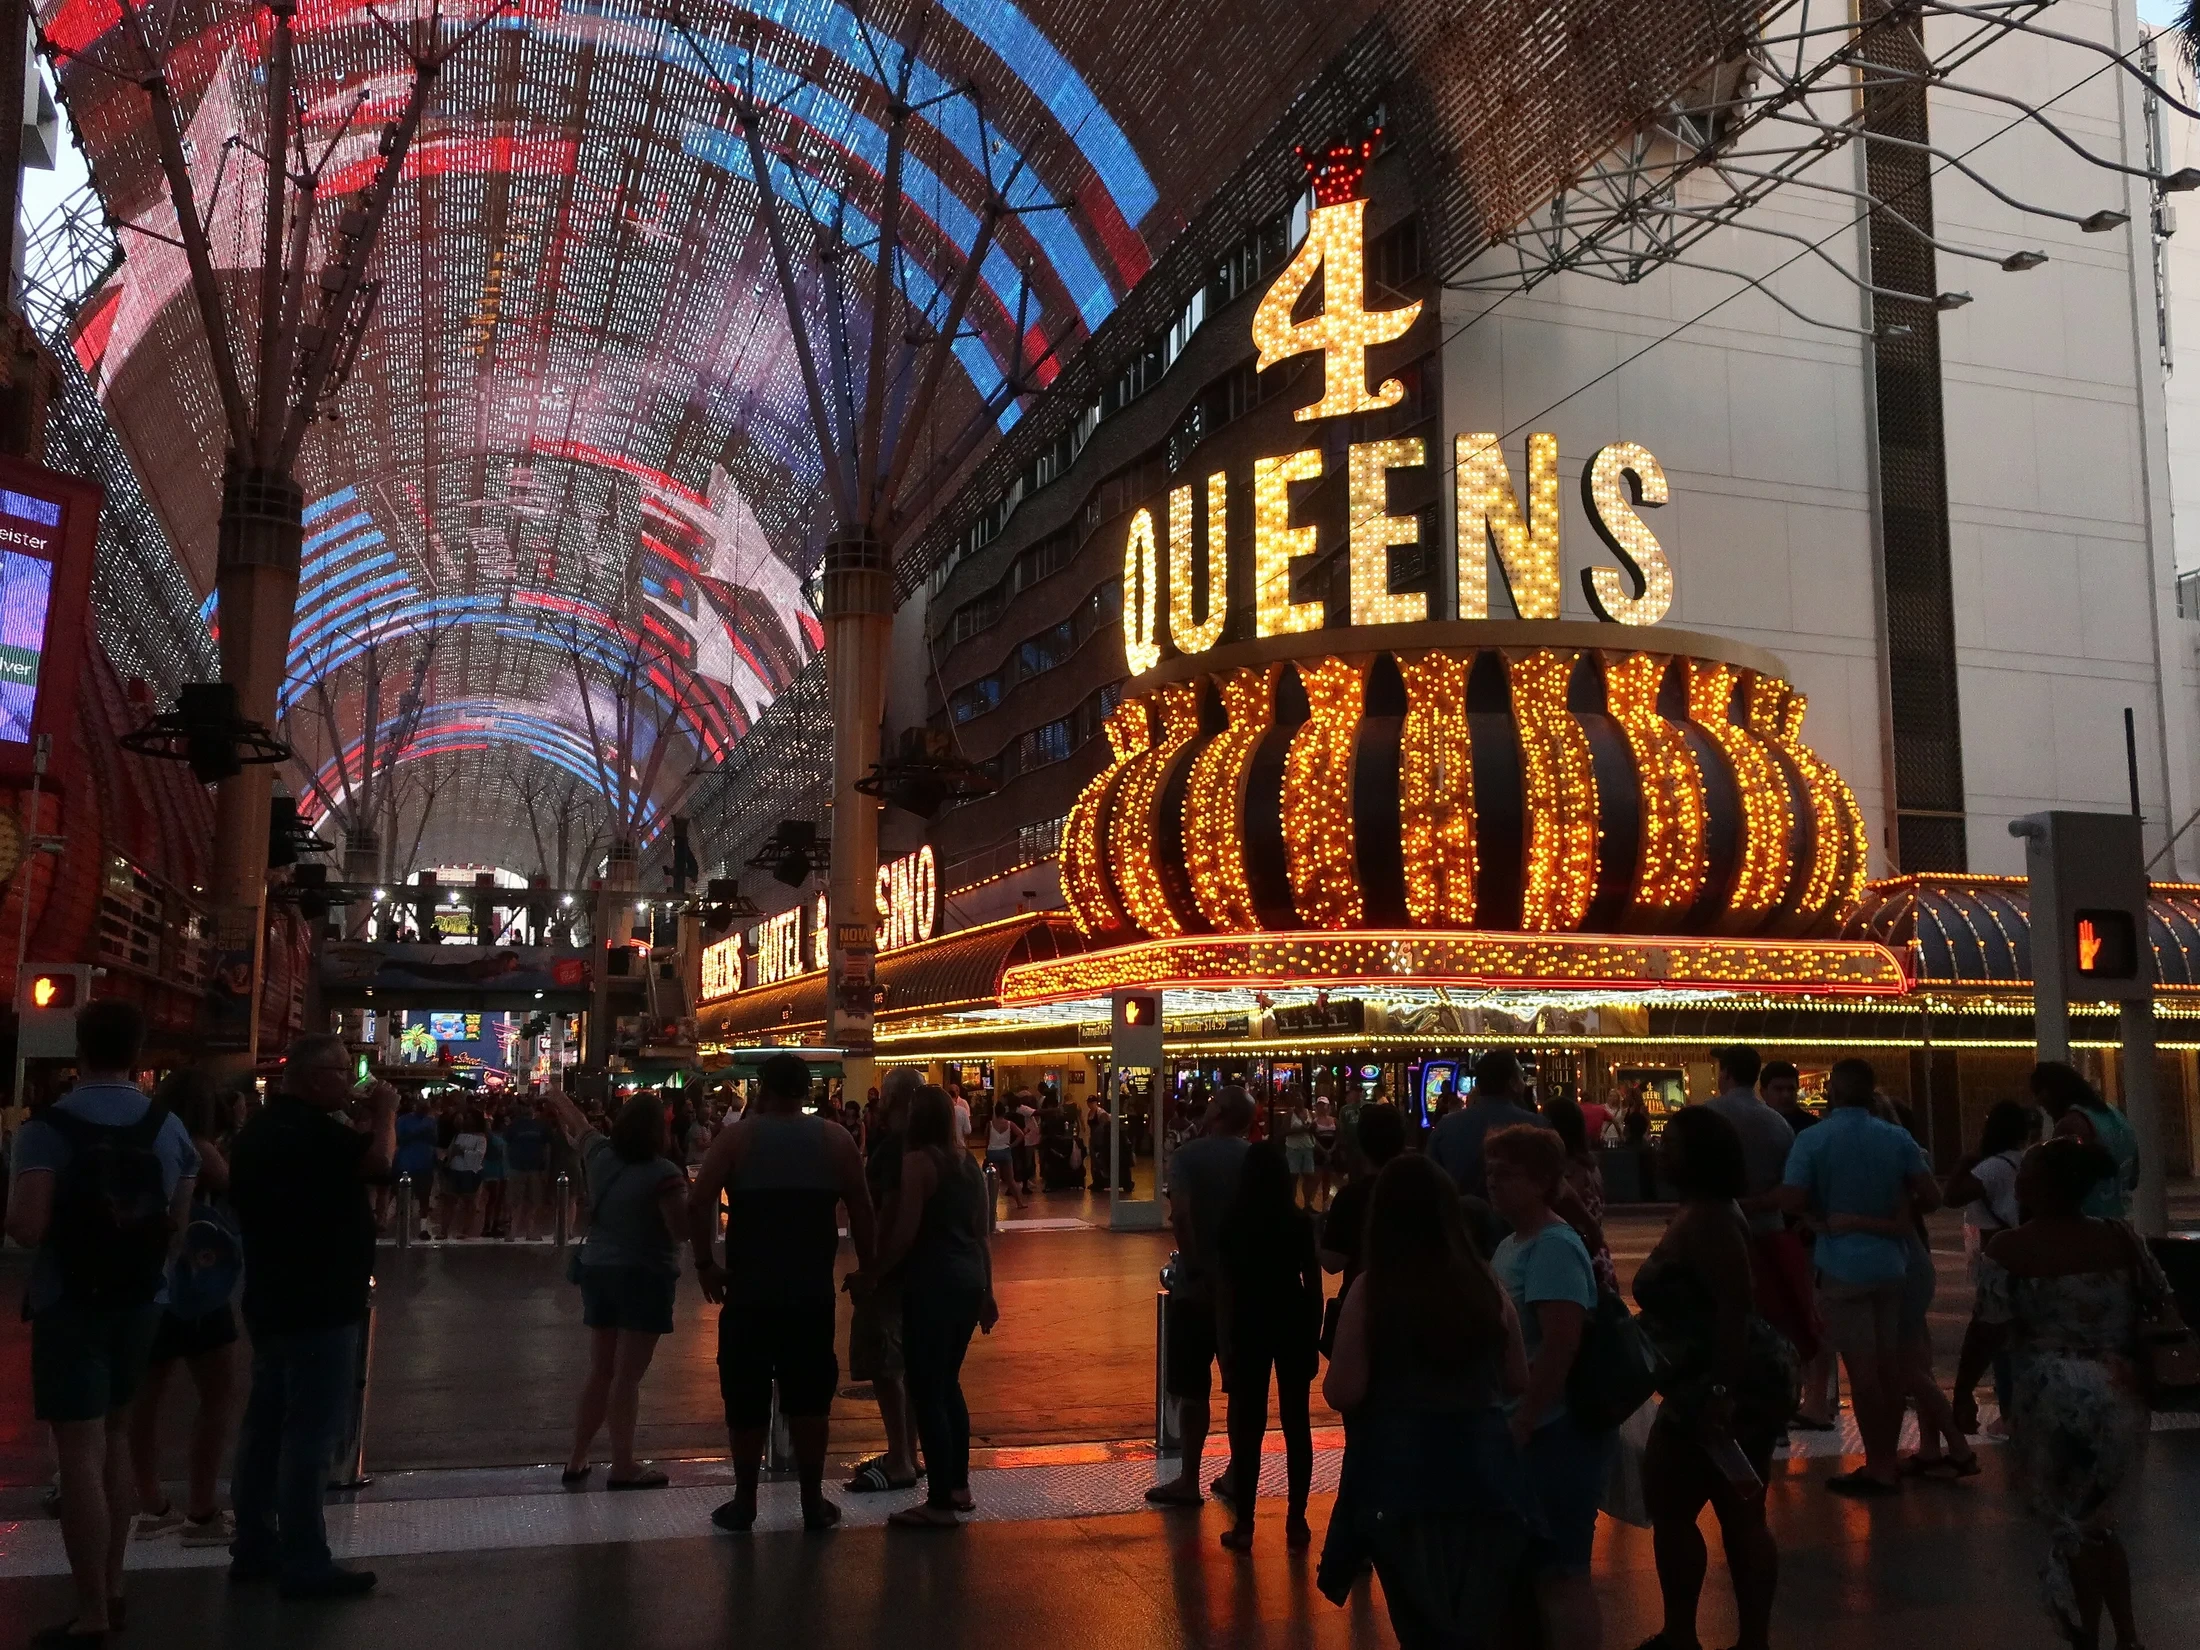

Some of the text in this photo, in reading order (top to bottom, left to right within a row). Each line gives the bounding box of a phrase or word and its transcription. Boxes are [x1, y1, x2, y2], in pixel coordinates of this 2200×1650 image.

[1252, 198, 1423, 422] 4
[0, 527, 48, 550] eister
[1123, 432, 1674, 676] QUEENS
[0, 656, 32, 676] lver
[757, 906, 803, 986] HOTEL
[875, 844, 936, 952] SINO
[1545, 1070, 1573, 1083] PULL
